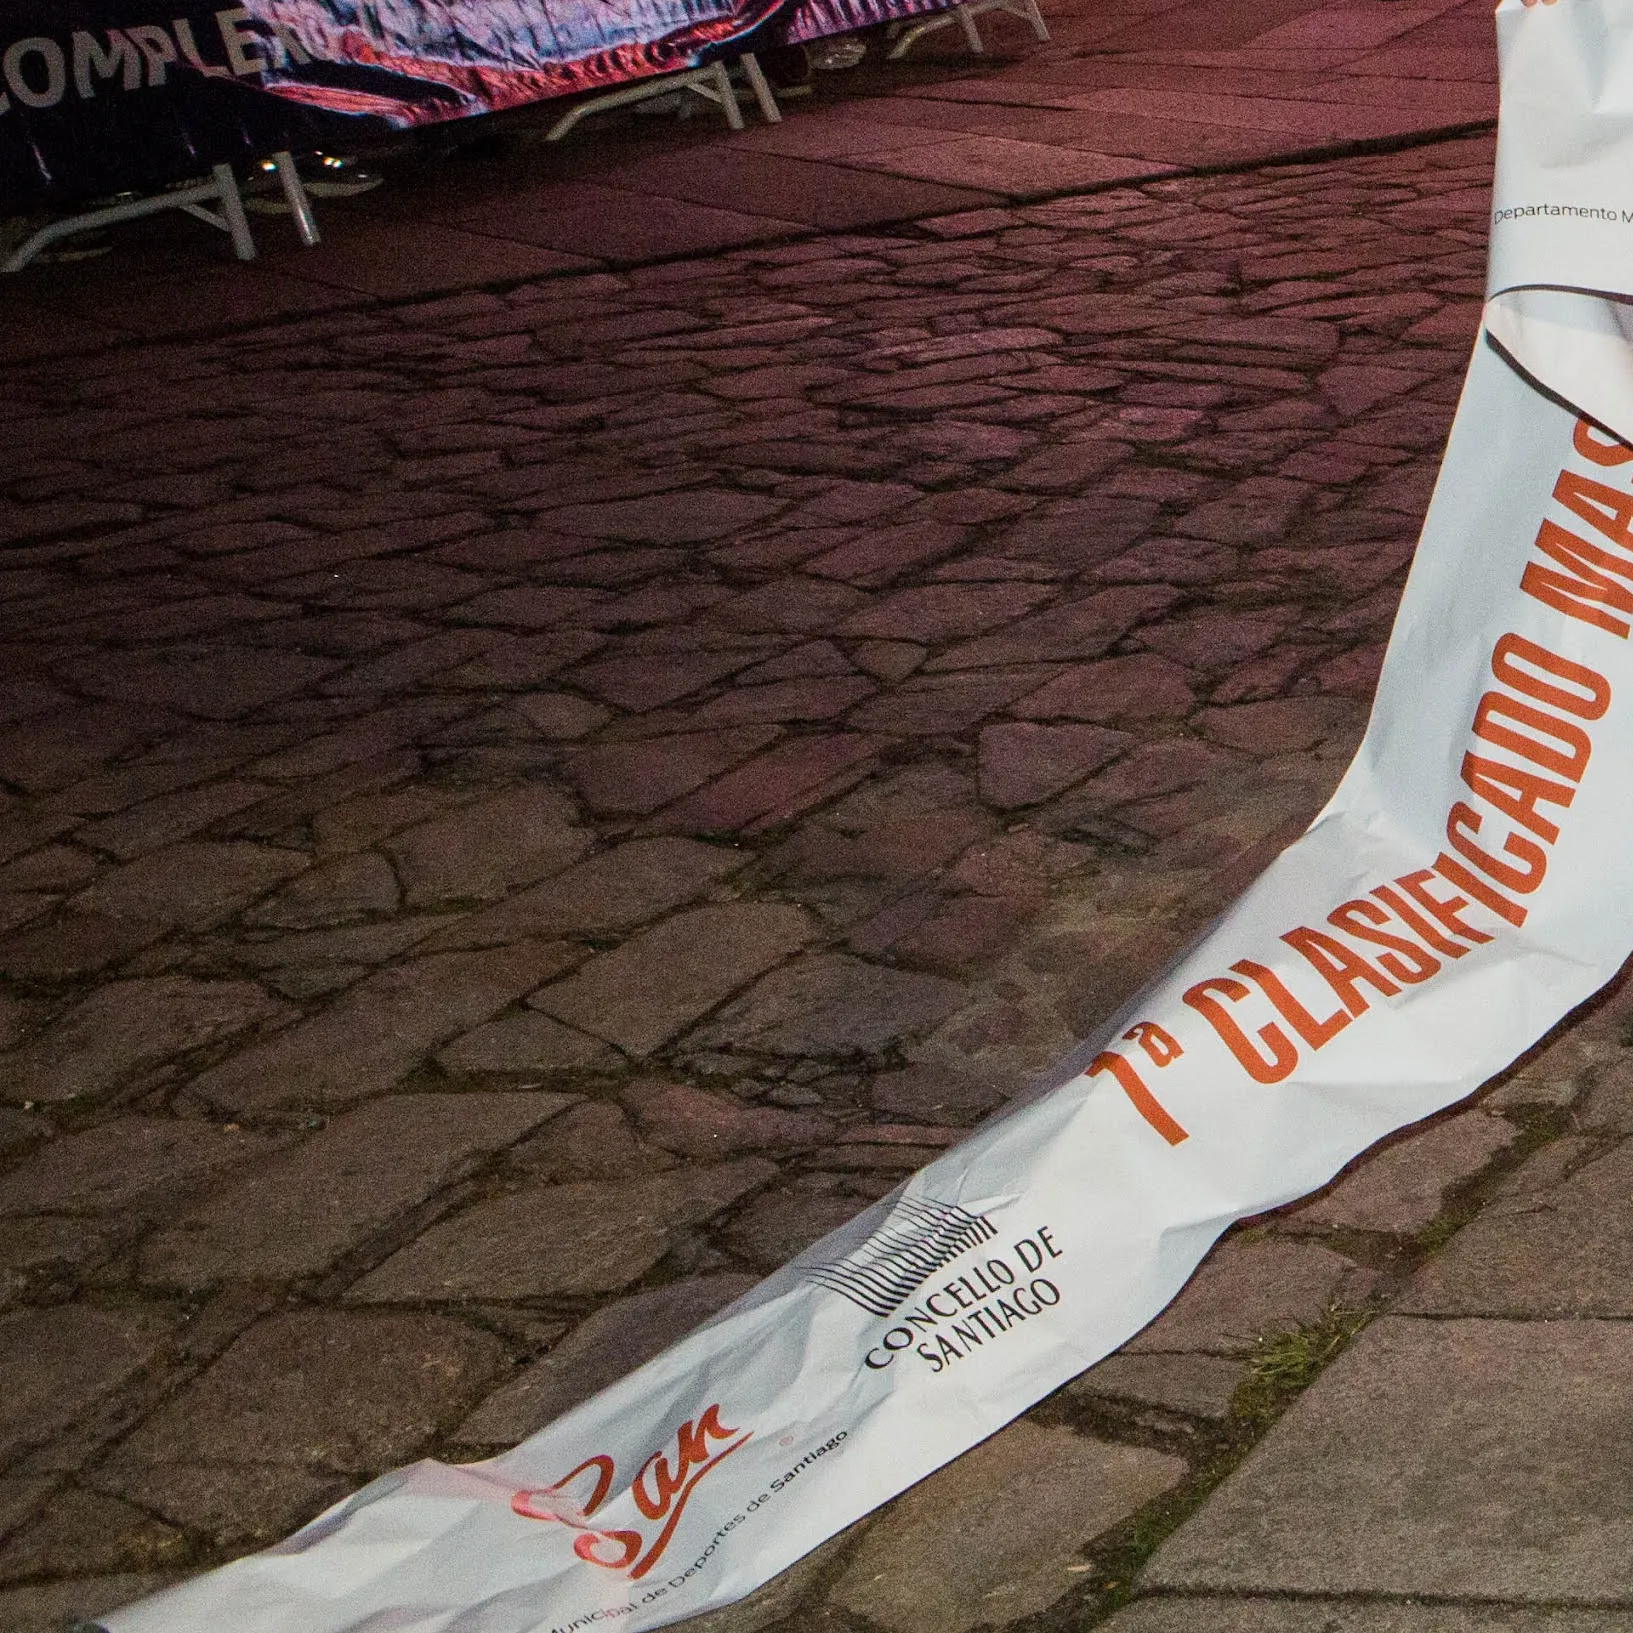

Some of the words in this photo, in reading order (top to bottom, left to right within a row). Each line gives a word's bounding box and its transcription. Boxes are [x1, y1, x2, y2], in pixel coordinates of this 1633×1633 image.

[1493, 202, 1617, 225] Departamento
[1183, 632, 1611, 1085] CLASIFICADO
[865, 1259, 1014, 1370] CONCELLO
[1019, 1225, 1064, 1272] DE
[917, 1278, 1061, 1374] SANTIAGO
[640, 1581, 667, 1605] de
[668, 1512, 746, 1586] Deportes
[747, 1491, 770, 1517] de
[769, 1430, 849, 1493] Santiago
